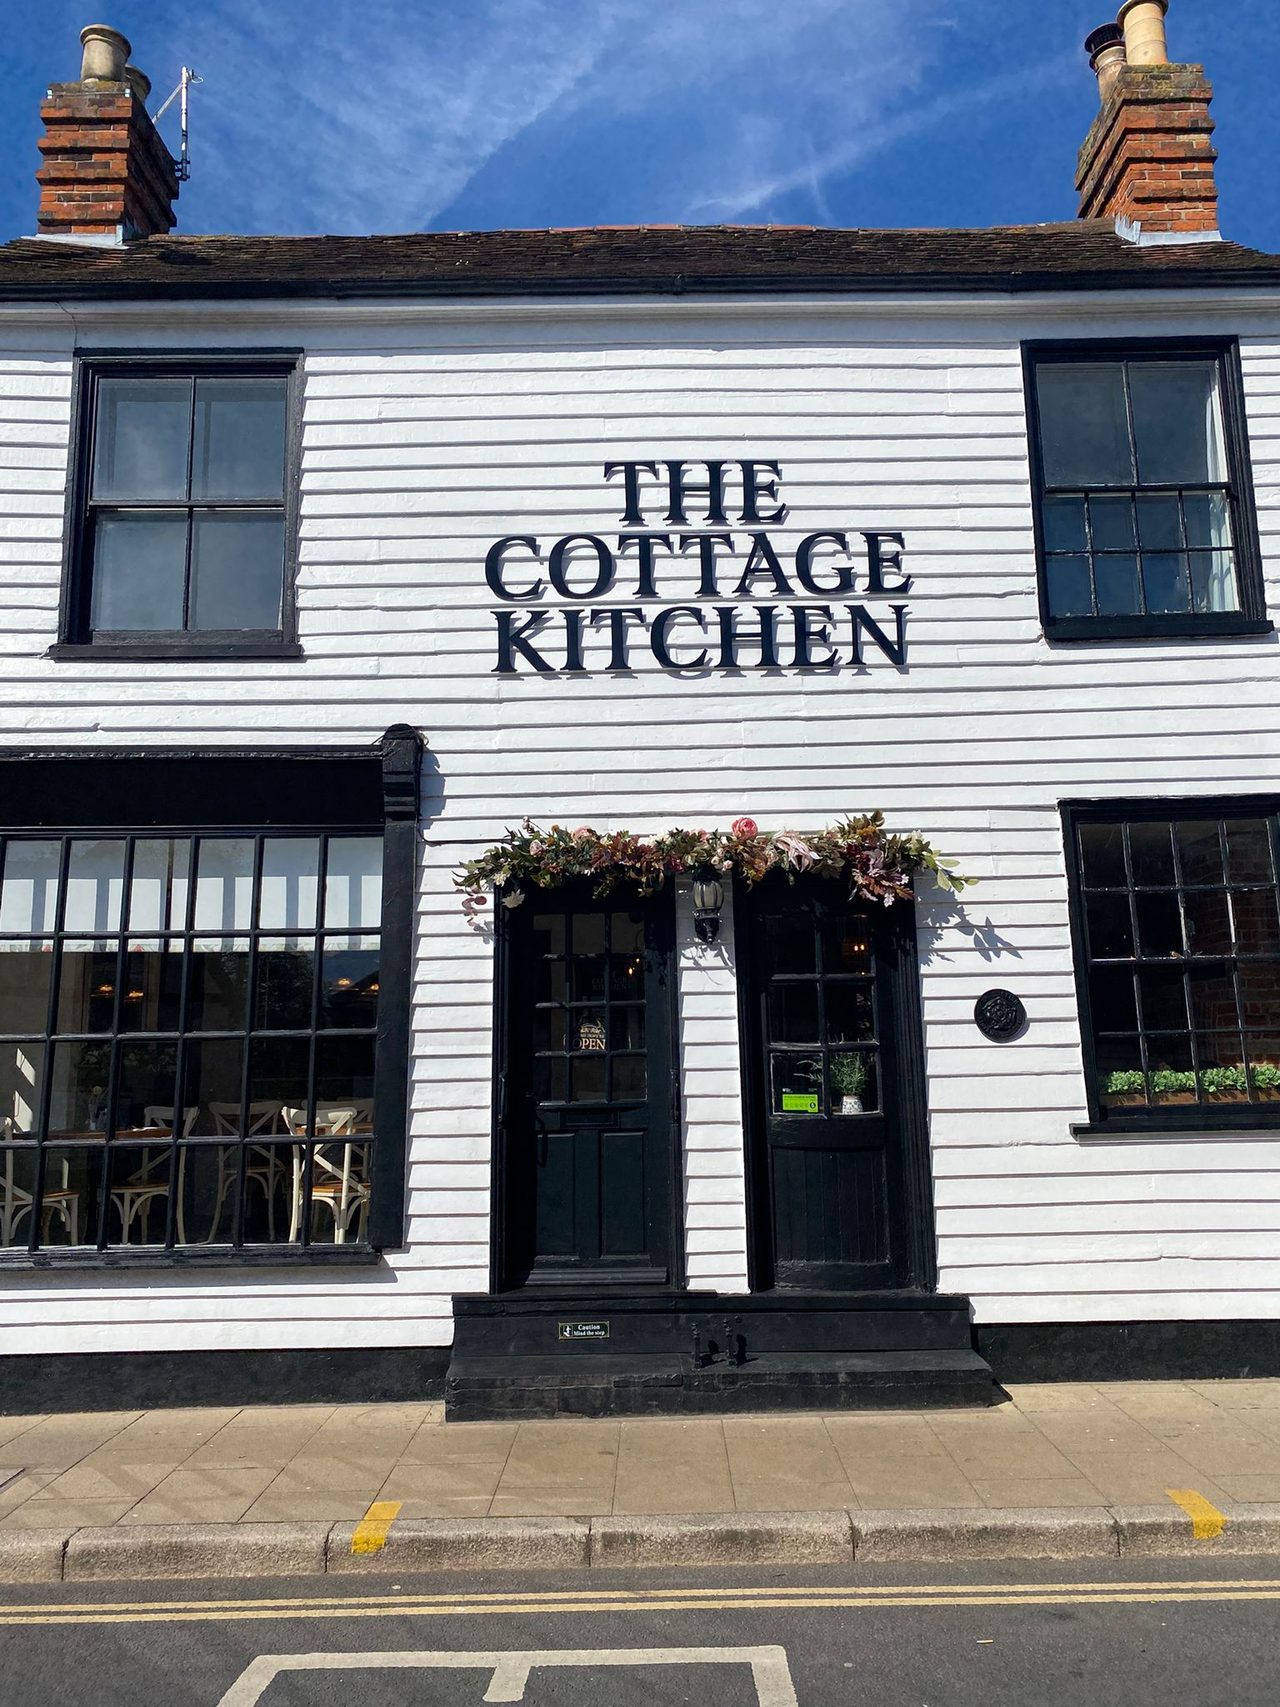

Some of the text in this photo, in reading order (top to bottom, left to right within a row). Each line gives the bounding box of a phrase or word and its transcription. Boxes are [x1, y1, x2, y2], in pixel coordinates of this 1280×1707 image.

[604, 459, 787, 524] THE
[484, 530, 912, 600] COTTAGE
[490, 603, 909, 673] KITCHEN
[573, 1038, 606, 1050] OPEN
